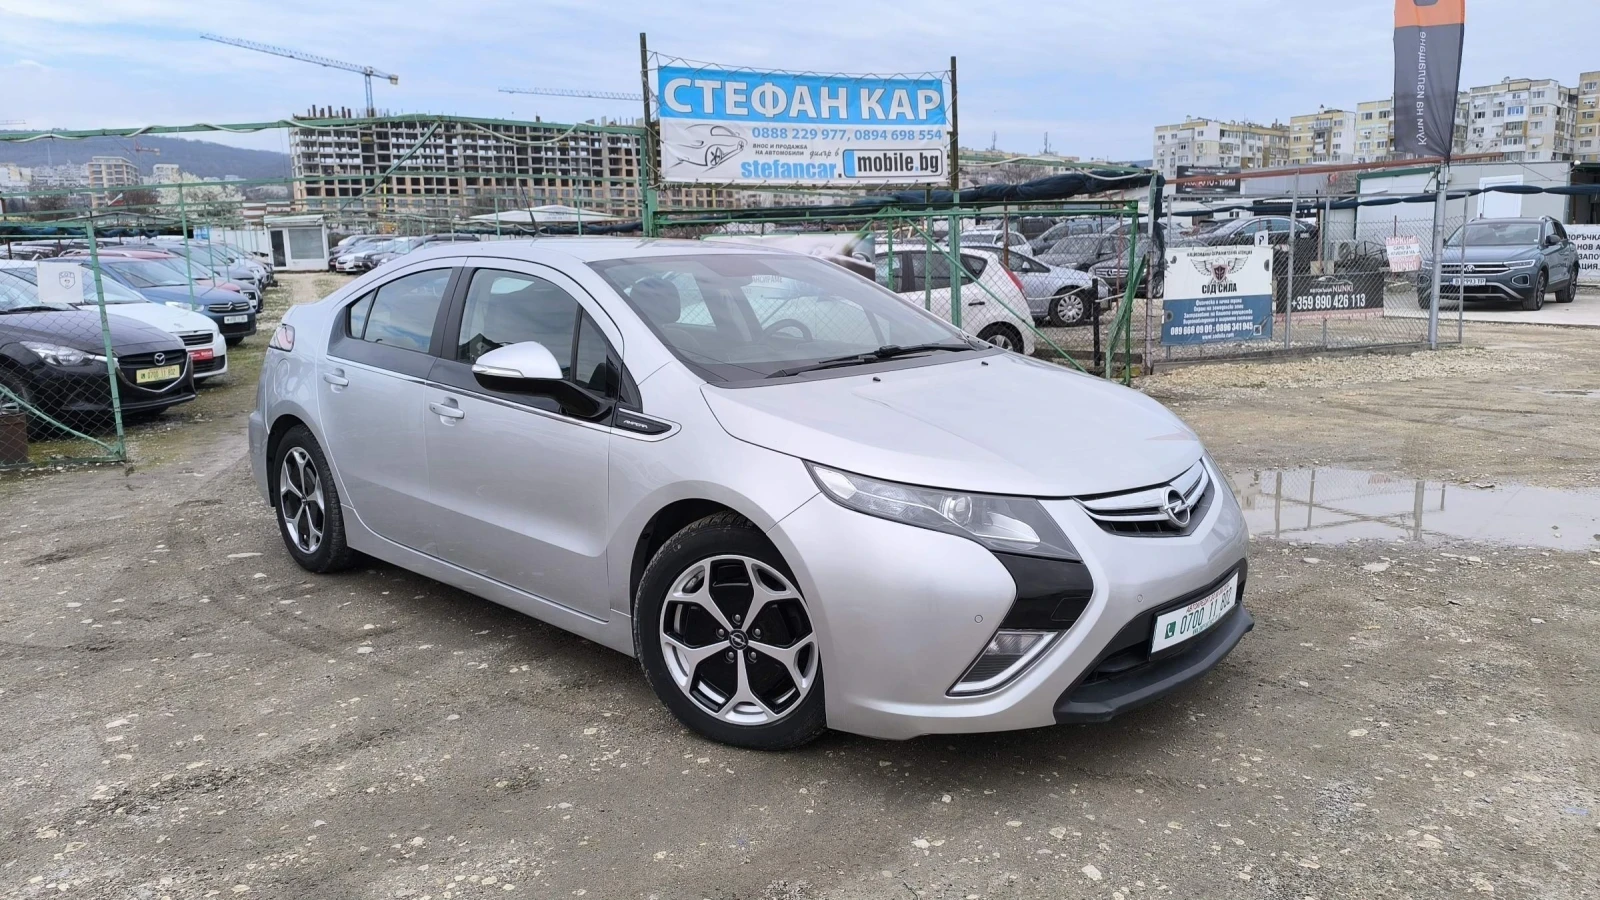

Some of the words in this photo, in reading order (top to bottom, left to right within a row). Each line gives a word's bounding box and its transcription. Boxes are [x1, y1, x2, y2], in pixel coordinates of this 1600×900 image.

[663, 77, 849, 119] СТЕФАН
[860, 88, 942, 121] КАР
[752, 127, 788, 141] 0888
[791, 128, 817, 141] 229
[821, 129, 850, 143] 977,
[854, 129, 887, 141] 0894
[891, 130, 916, 141] 698
[919, 130, 942, 141] 554
[809, 149, 832, 159] дилър
[857, 150, 940, 173] mobile.bg
[1201, 284, 1217, 294] СОД
[1218, 283, 1237, 293] СИЛА
[1332, 284, 1354, 293] NUNKI
[1292, 295, 1314, 310] +359
[1315, 294, 1331, 309] 890
[1333, 294, 1348, 308] 426
[1351, 293, 1366, 307] 113
[1170, 326, 1182, 335] 089
[1231, 322, 1242, 331] 341
[1180, 607, 1204, 634] 0700
[1209, 598, 1218, 620] 11
